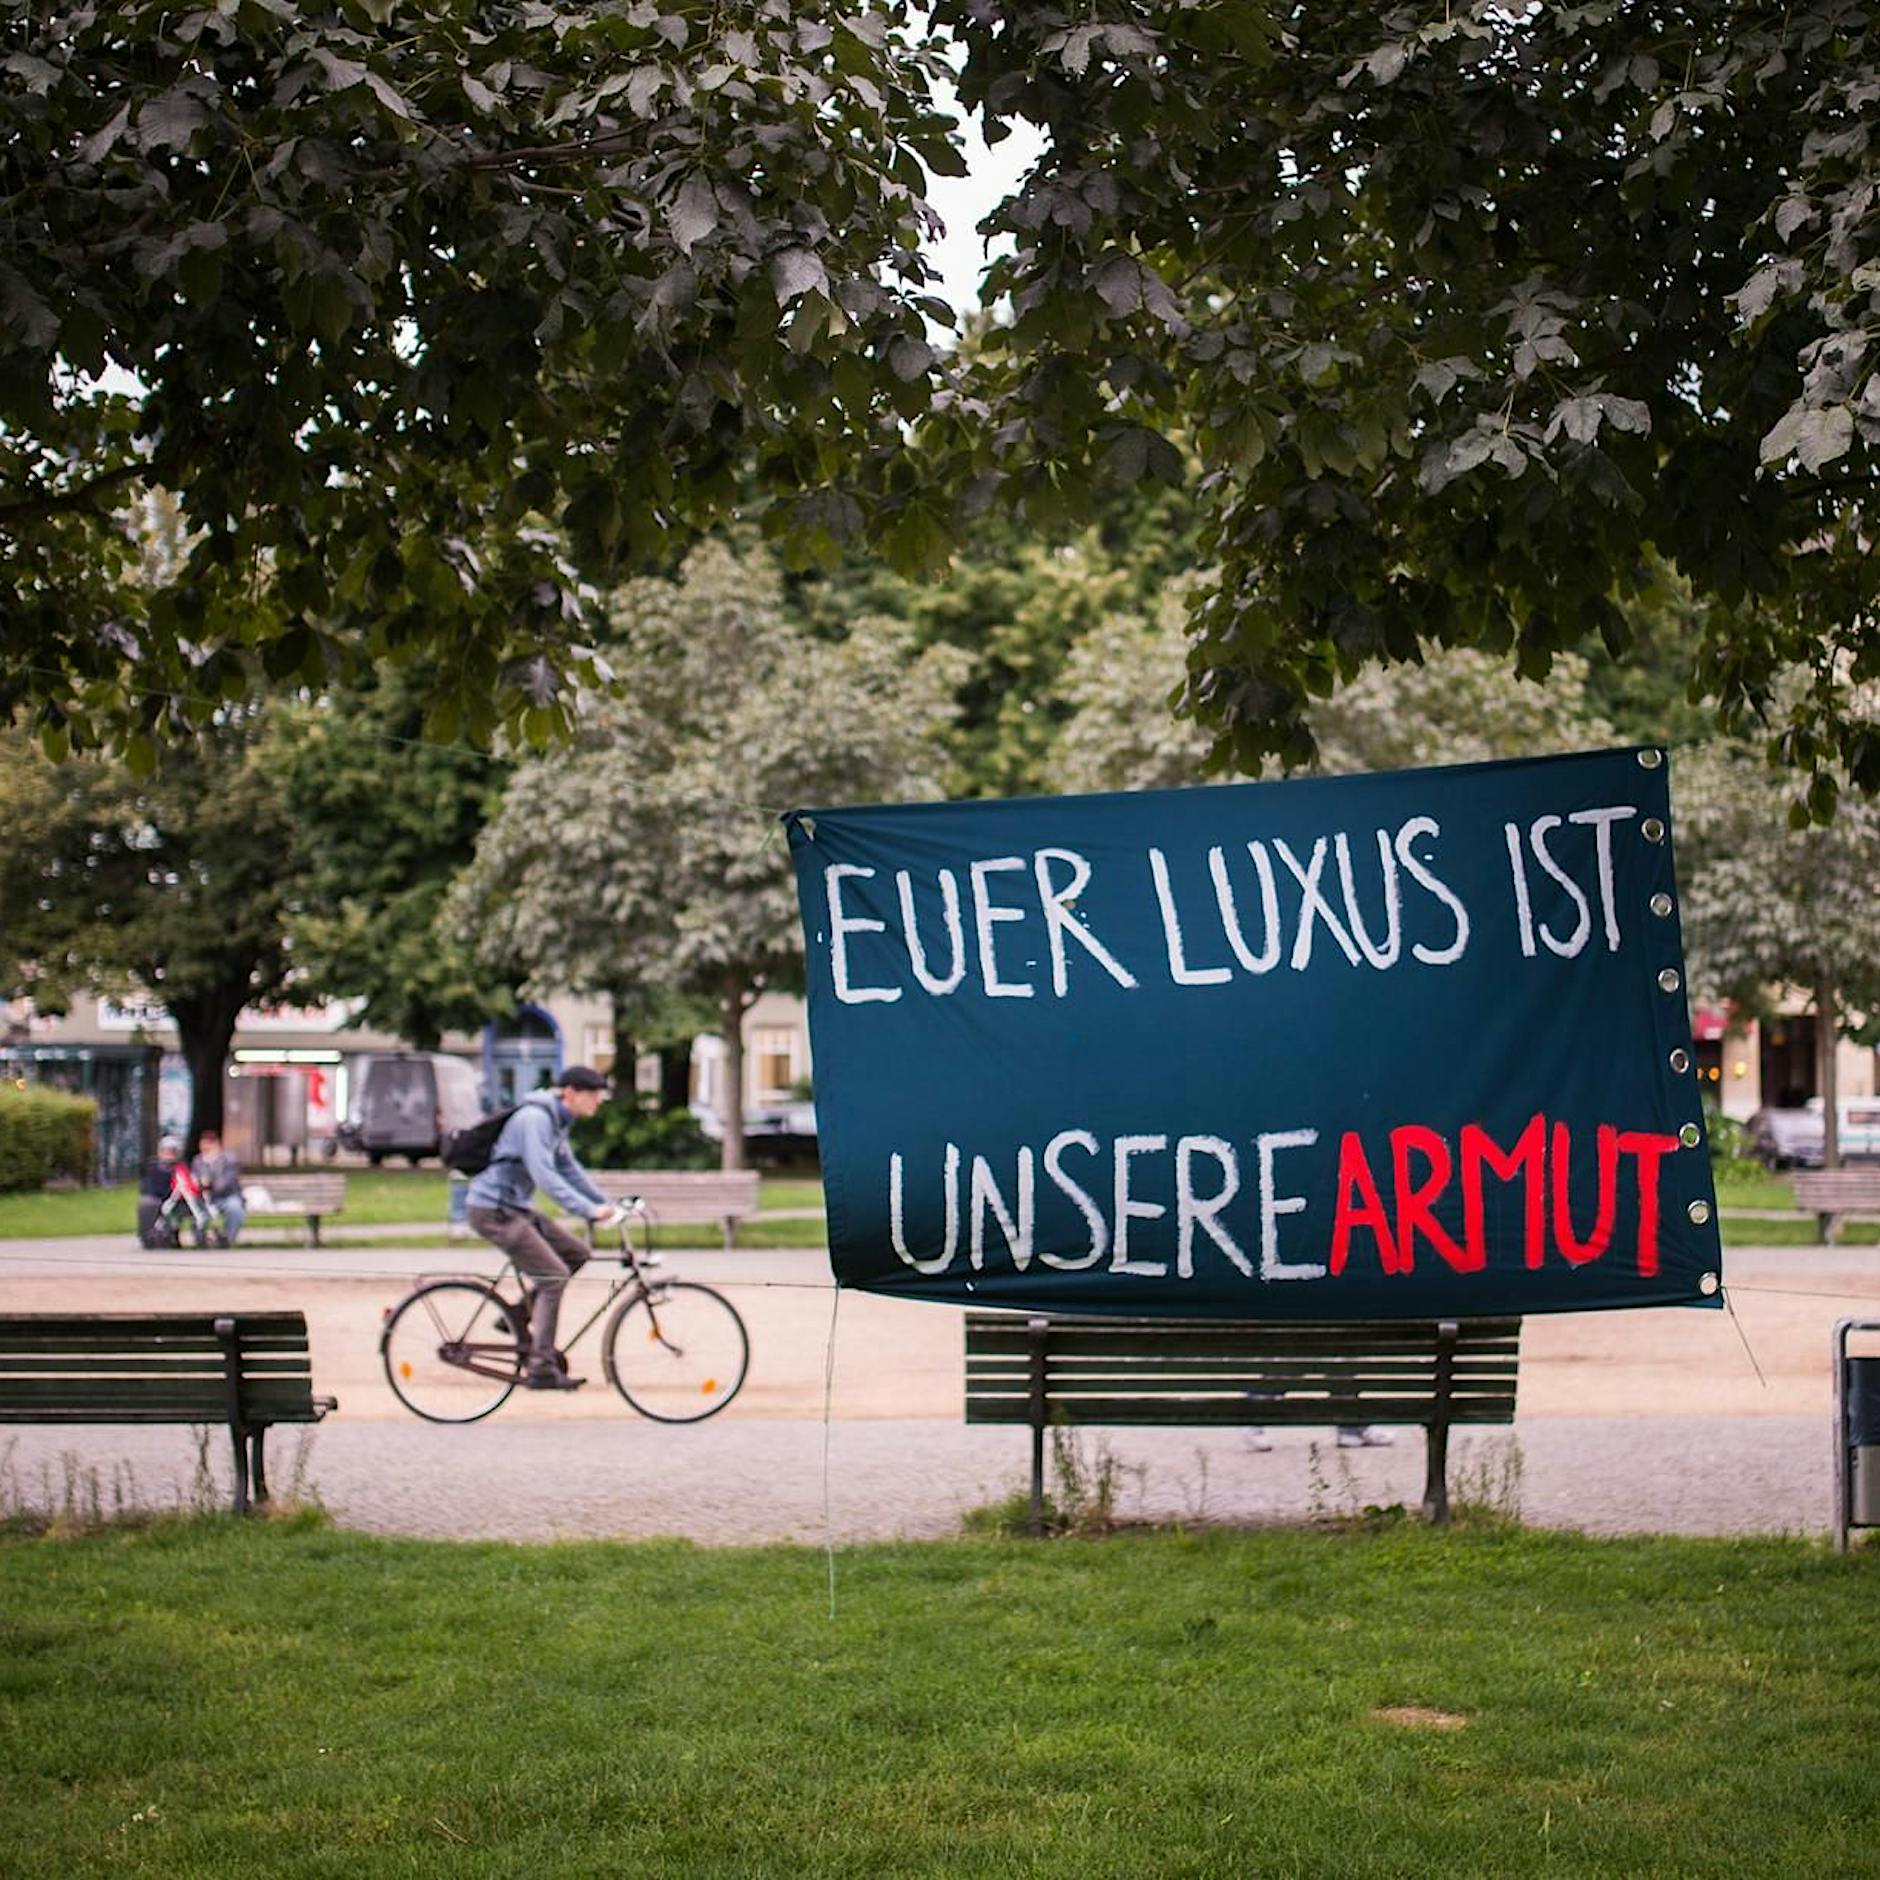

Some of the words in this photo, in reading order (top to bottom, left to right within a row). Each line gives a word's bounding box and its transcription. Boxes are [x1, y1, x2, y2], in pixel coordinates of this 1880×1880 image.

[825, 849, 1138, 1004] EUER
[1150, 816, 1470, 986] LUXUS
[1504, 806, 1637, 958] IST
[890, 1129, 1326, 1281] UNSERE
[1329, 1112, 1680, 1277] ARMUT
